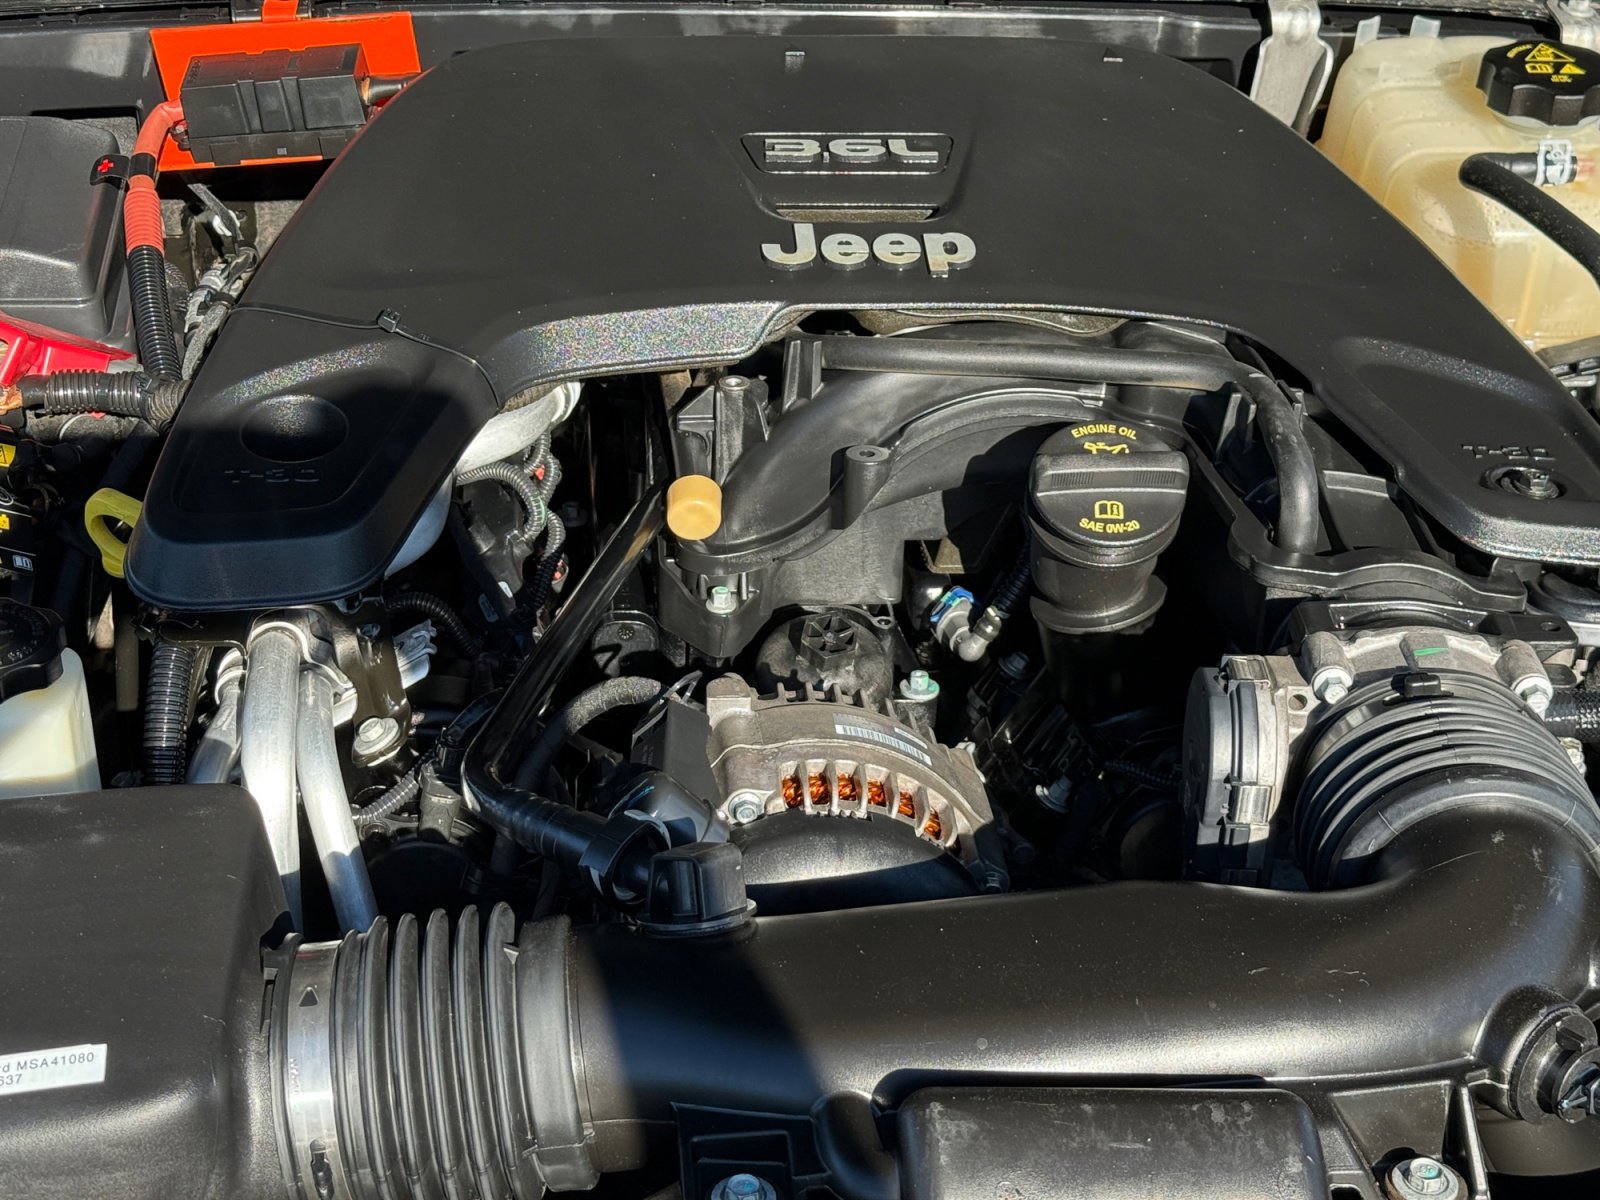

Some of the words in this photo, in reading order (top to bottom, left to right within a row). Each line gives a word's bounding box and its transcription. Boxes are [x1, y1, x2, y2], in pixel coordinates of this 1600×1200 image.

[764, 138, 940, 163] 3.6L
[761, 223, 977, 278] Jeep
[1071, 424, 1117, 439] ENGINE
[1118, 426, 1138, 440] OIL
[1079, 517, 1104, 532] SAE
[1105, 519, 1141, 534] 0W-20
[0, 1062, 10, 1073] d
[16, 1051, 95, 1071] MSA41080
